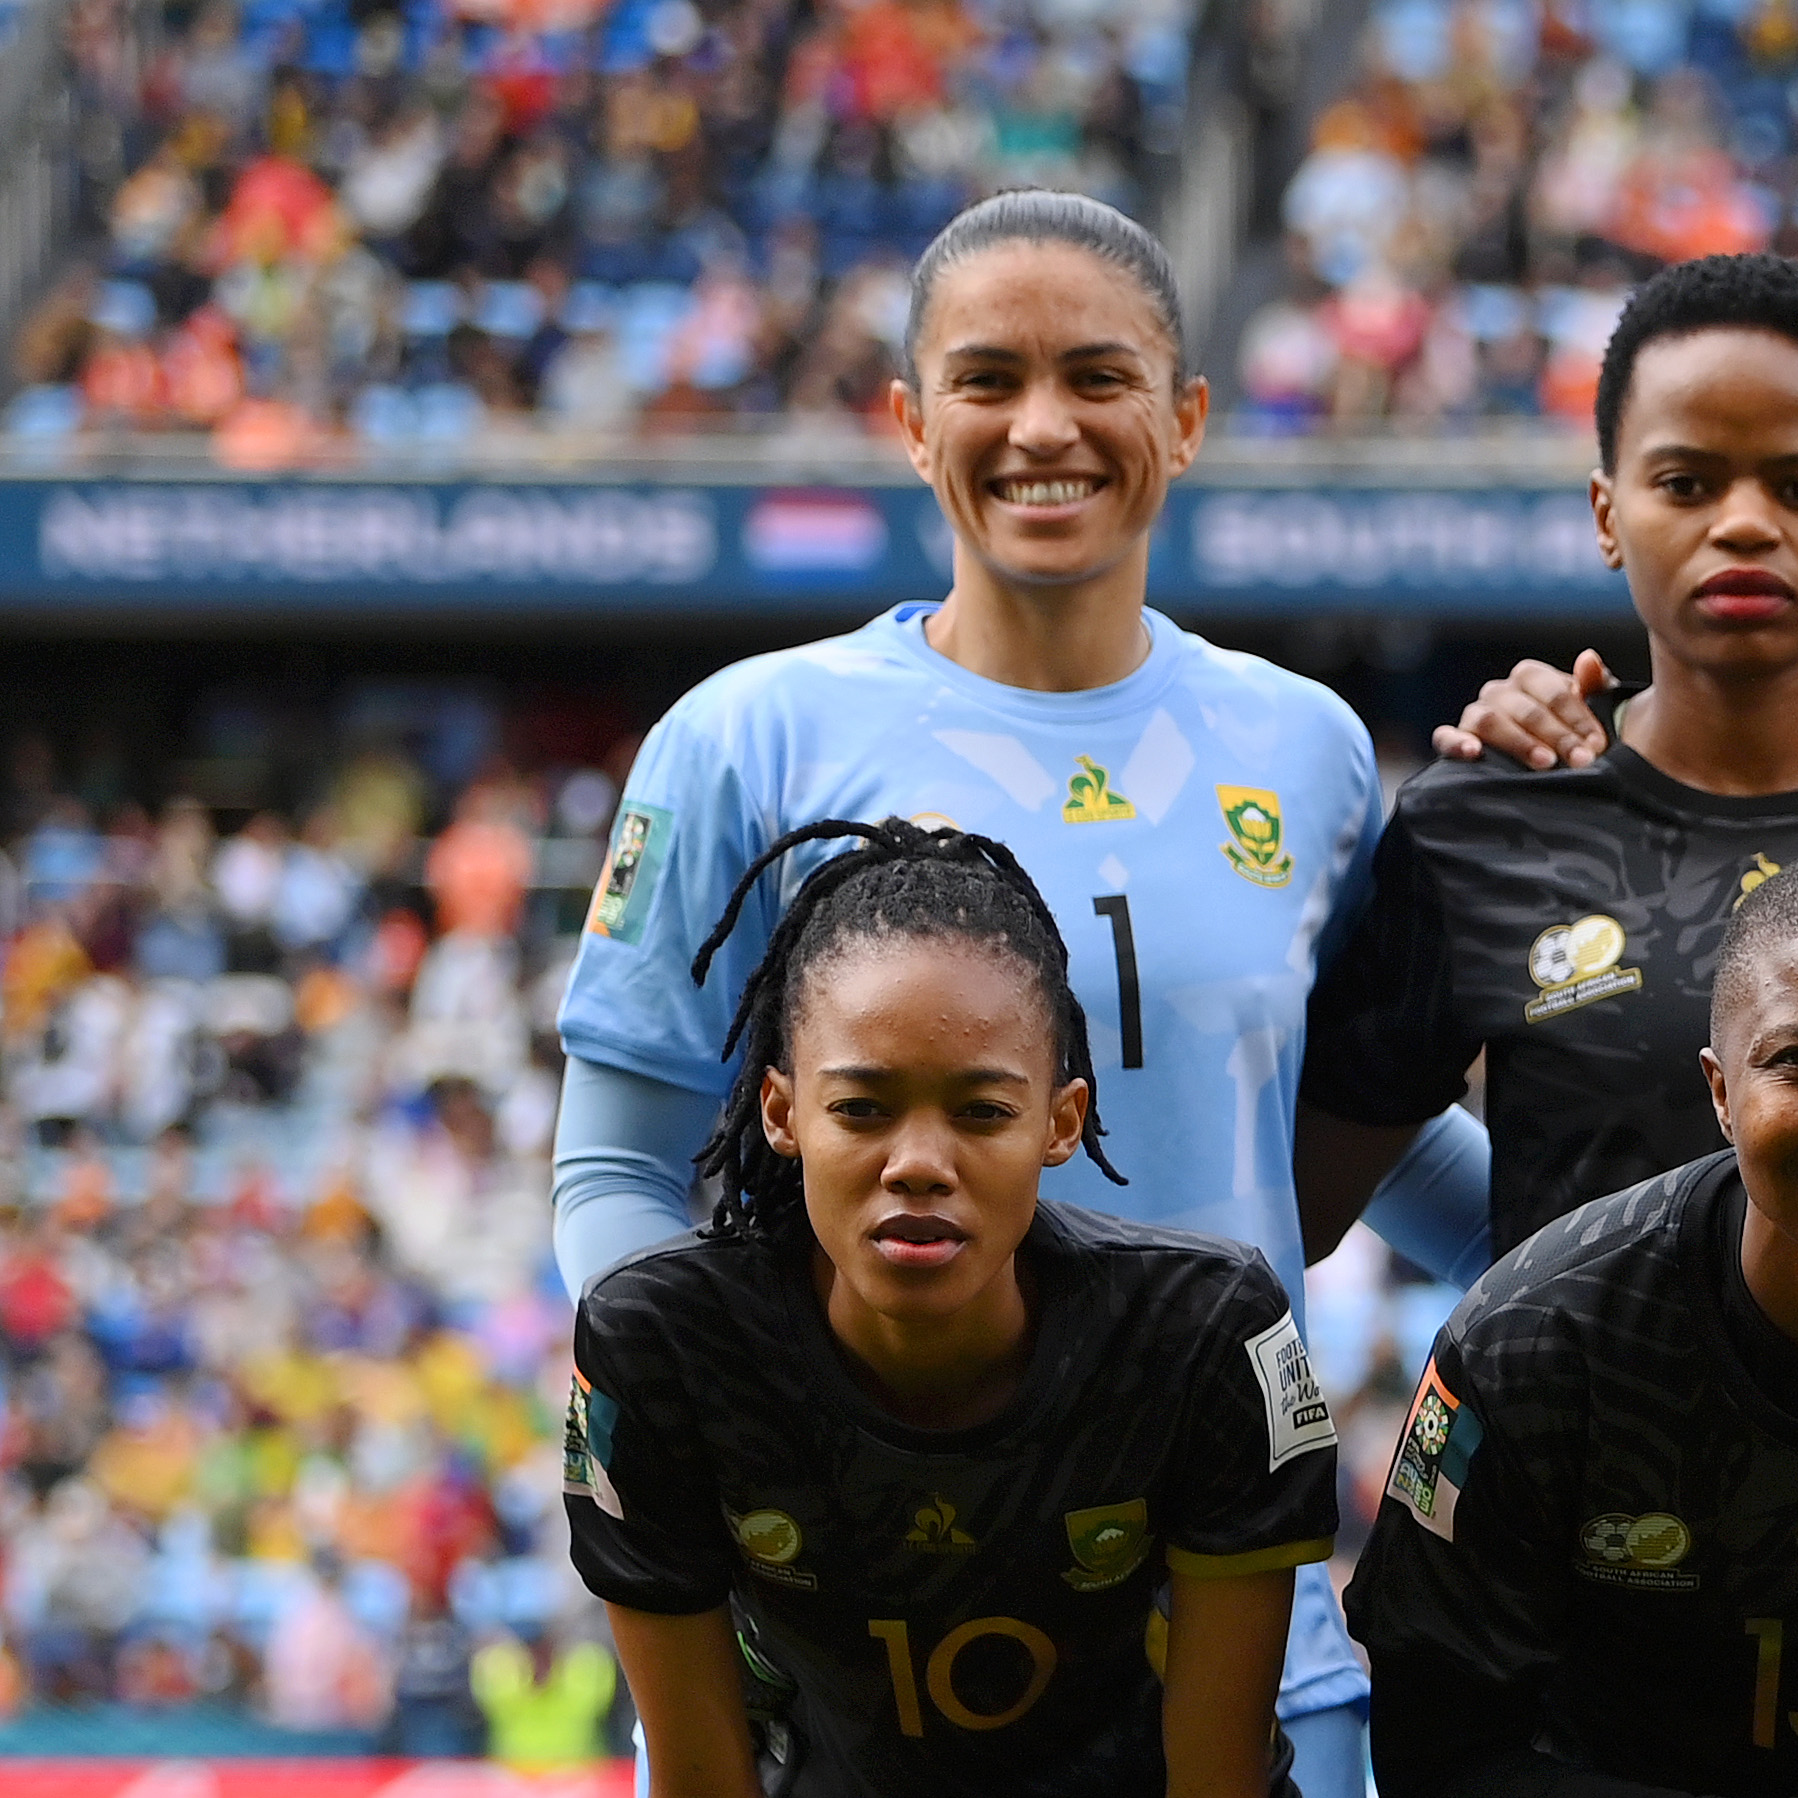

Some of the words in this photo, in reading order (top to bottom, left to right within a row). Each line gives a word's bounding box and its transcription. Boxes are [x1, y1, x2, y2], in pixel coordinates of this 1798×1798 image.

[1093, 894, 1143, 1070] 1
[1296, 1408, 1327, 1425] FIFA
[868, 1616, 1057, 1738] 10
